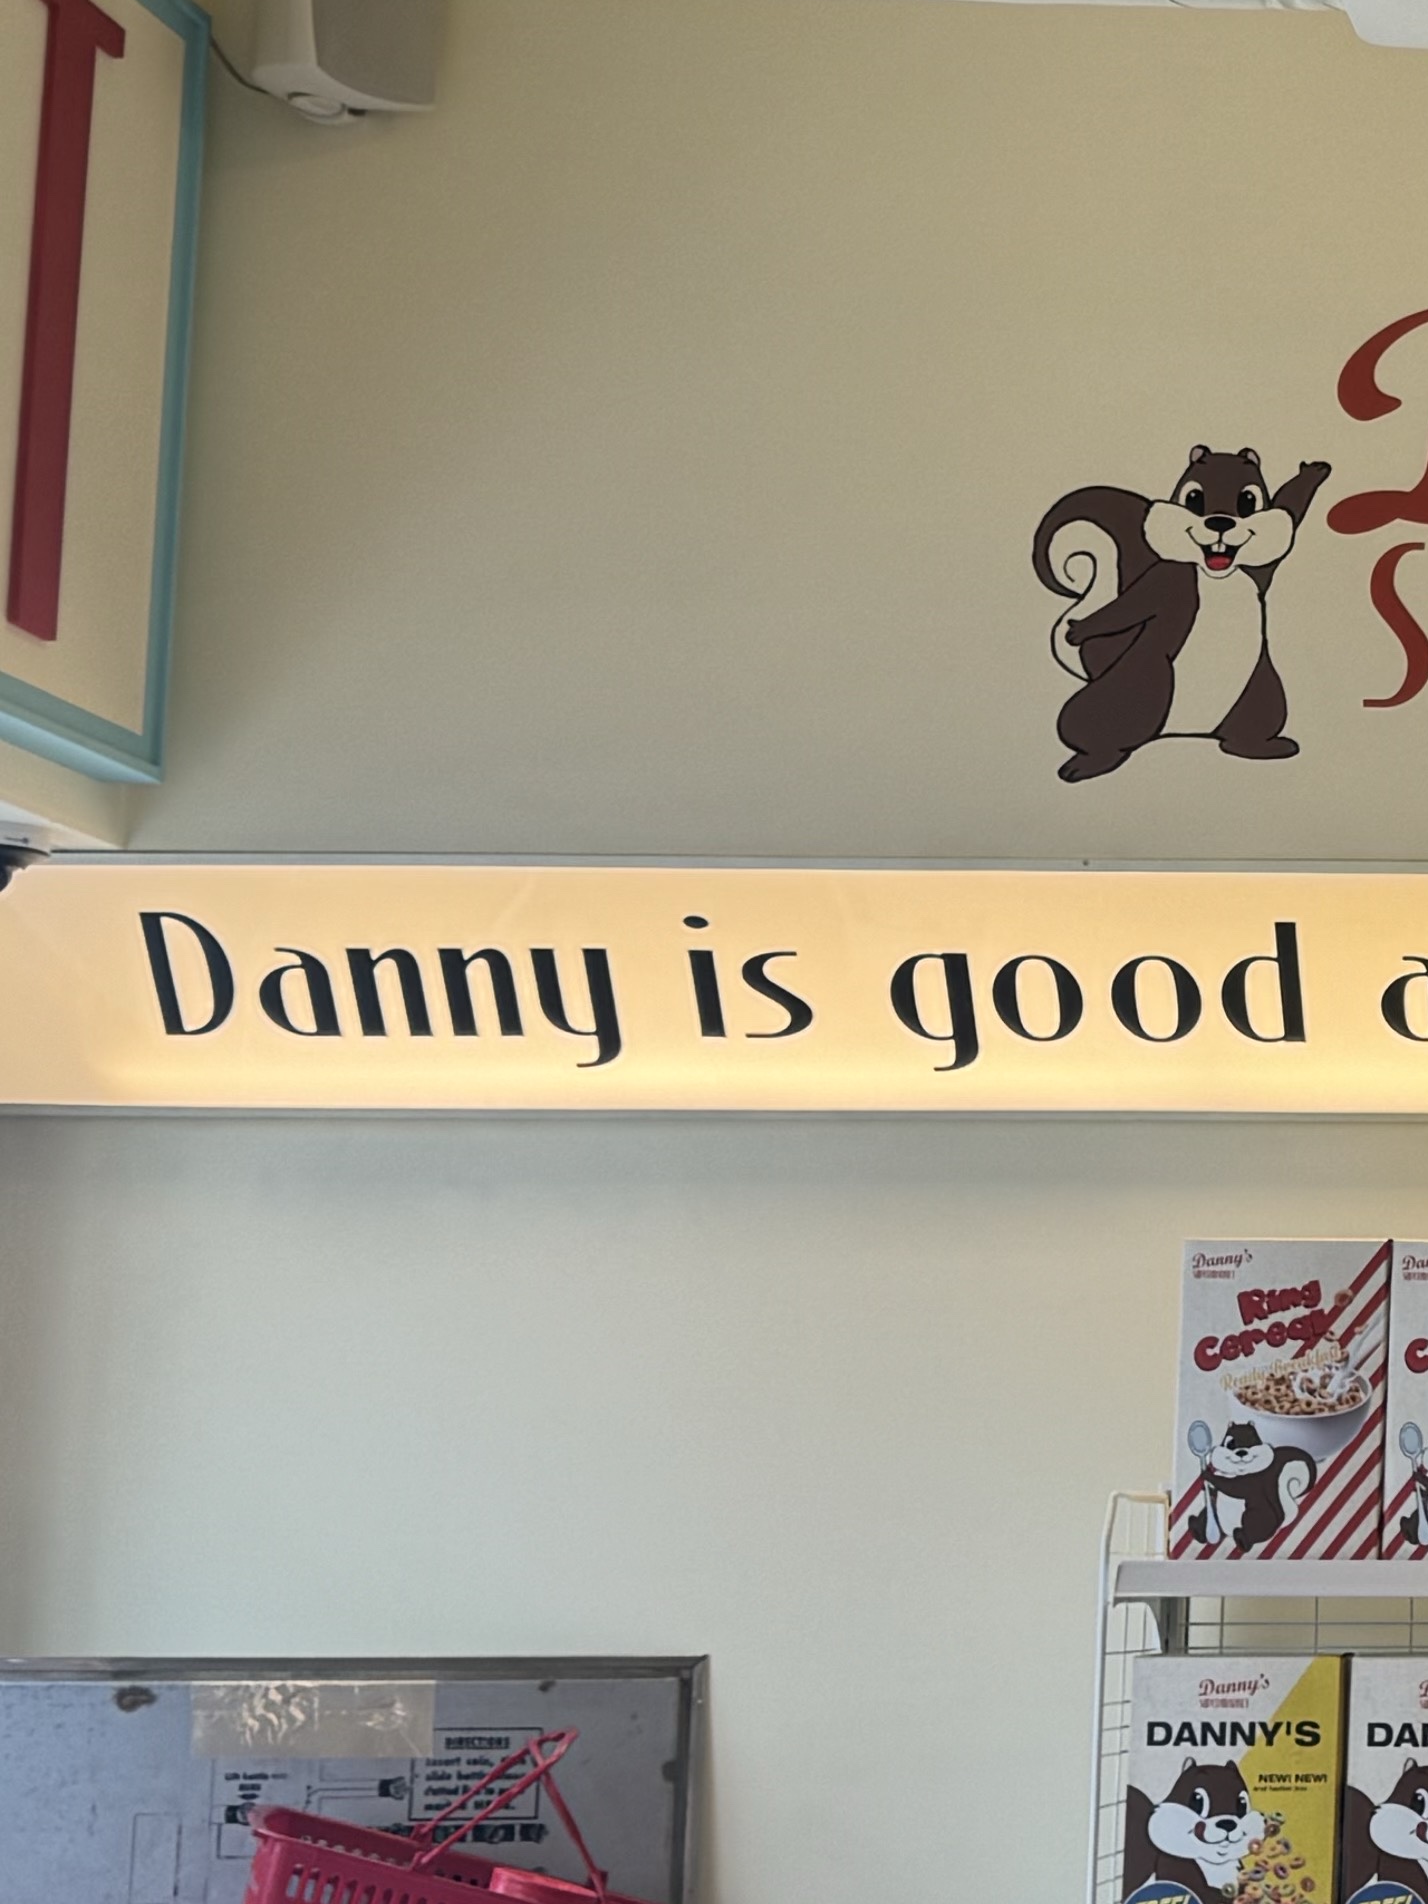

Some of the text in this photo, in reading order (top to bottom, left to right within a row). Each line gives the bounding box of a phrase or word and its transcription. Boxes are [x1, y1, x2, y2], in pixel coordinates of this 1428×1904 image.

[137, 908, 622, 1069] Danny
[682, 914, 815, 1039] is
[889, 920, 1307, 1072] good
[1192, 1249, 1252, 1269] Danny's
[1237, 1280, 1322, 1326] Ring
[1194, 1308, 1329, 1371] Cereal
[1199, 1674, 1270, 1696] Danny's
[1147, 1720, 1321, 1747] DANNY'S
